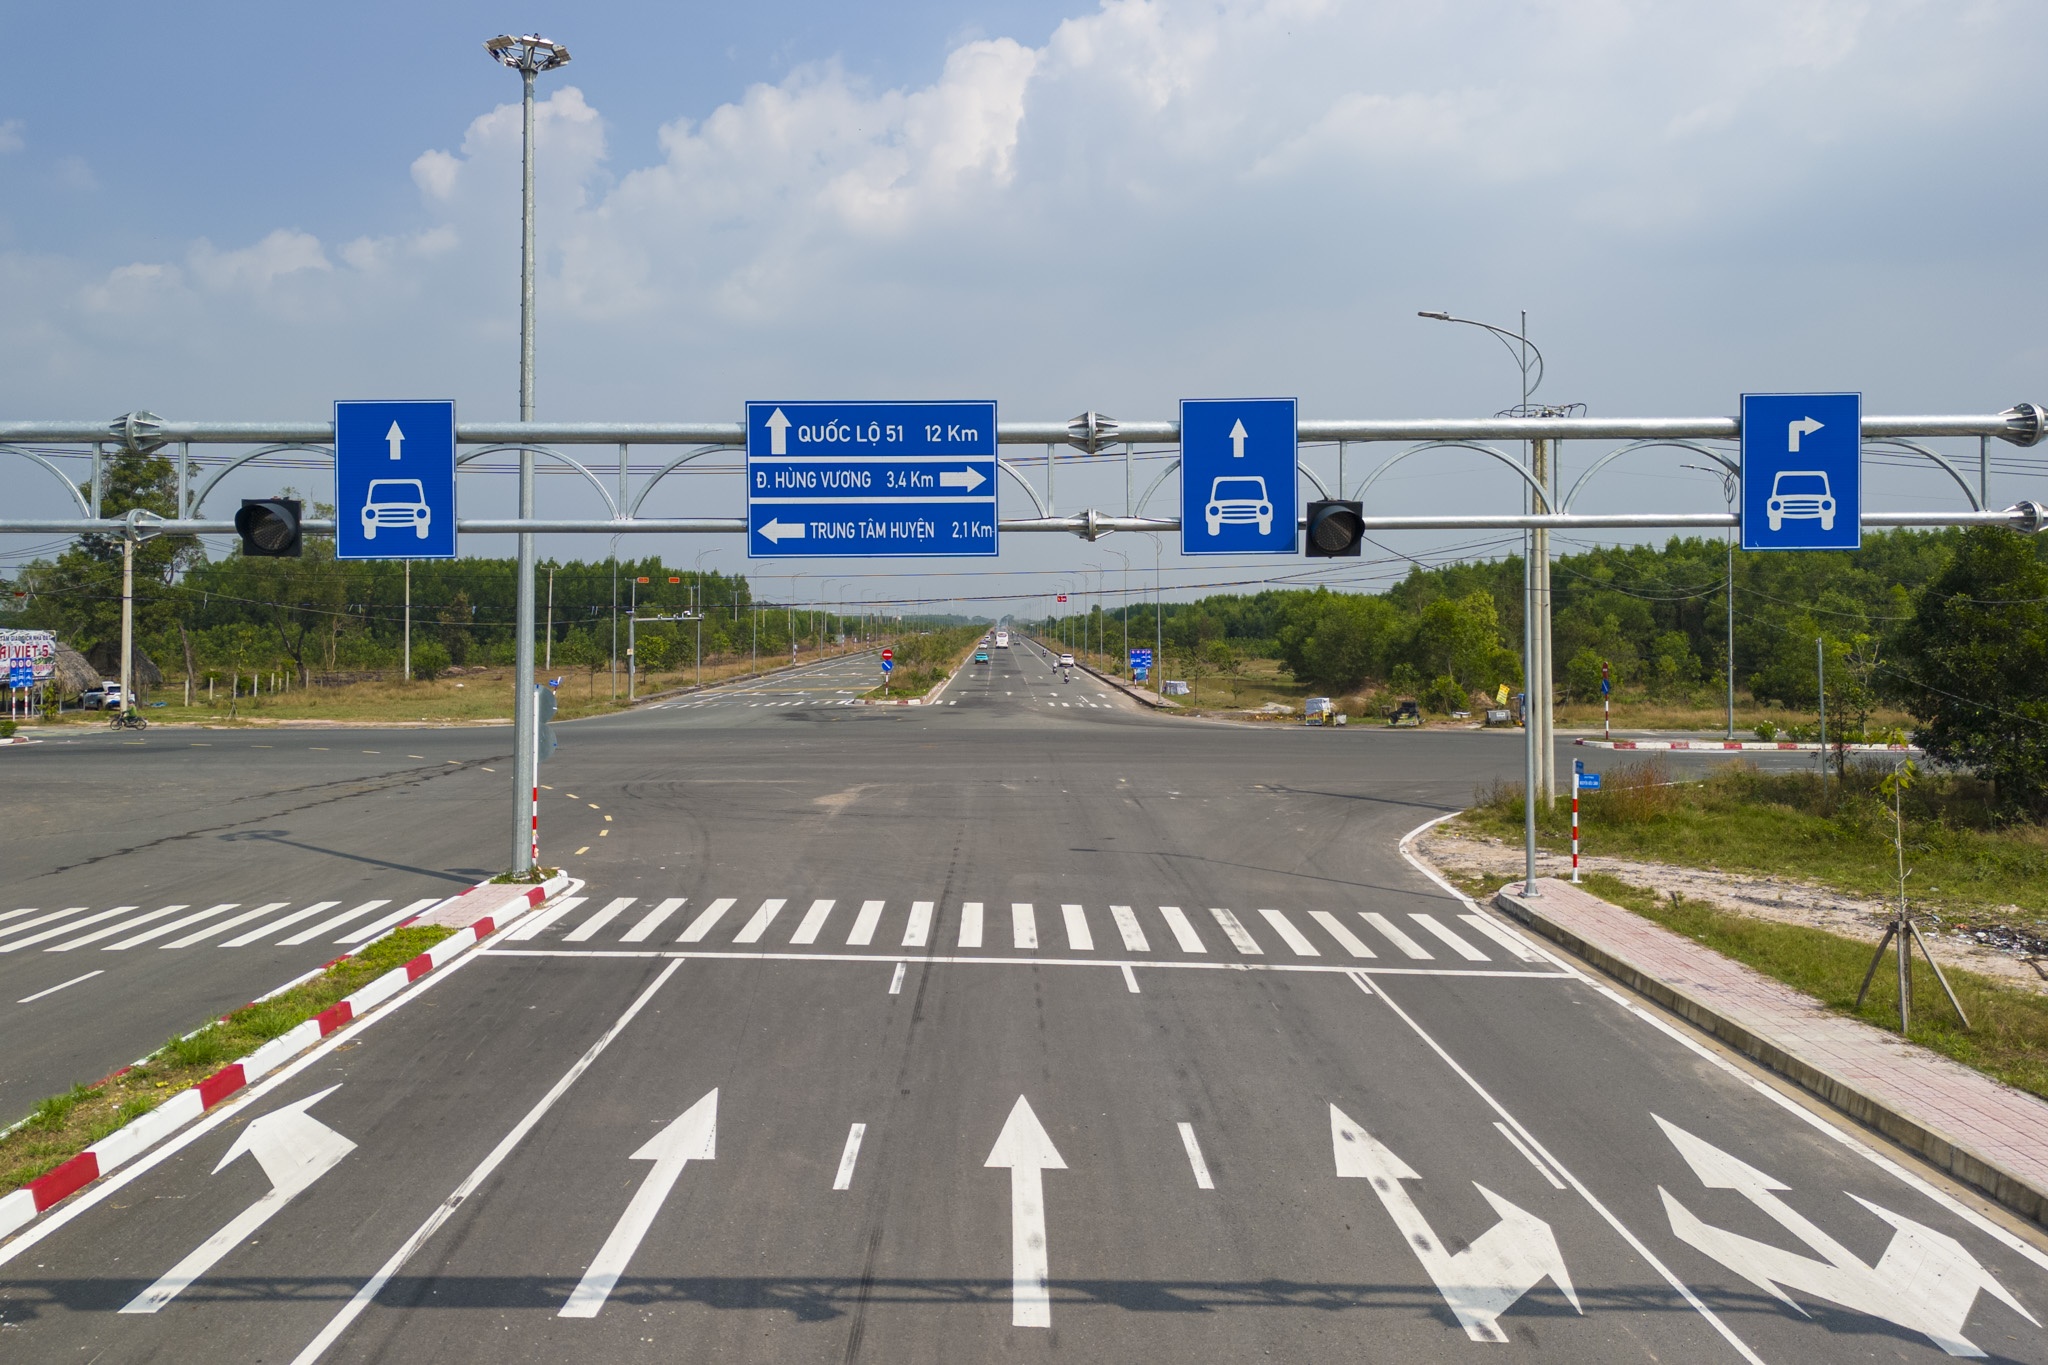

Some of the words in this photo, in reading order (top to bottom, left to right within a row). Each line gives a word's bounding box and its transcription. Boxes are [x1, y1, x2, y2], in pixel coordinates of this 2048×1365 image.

[798, 418, 851, 443] QUỐC
[856, 421, 881, 446] LỘ
[886, 425, 903, 442] 51
[925, 424, 942, 442] 12
[947, 424, 978, 442] Km
[756, 471, 771, 489] Đ.
[775, 466, 817, 489] HÙNG
[820, 469, 872, 489] VƯƠNG
[886, 470, 907, 489] 3,4
[910, 470, 934, 488] Km
[809, 521, 856, 539] TRUNG
[858, 518, 886, 539] TÂM
[890, 517, 935, 542] HUYỆN
[951, 521, 968, 539] 2,1
[971, 520, 992, 538] Km
[42, 644, 49, 658] 5
